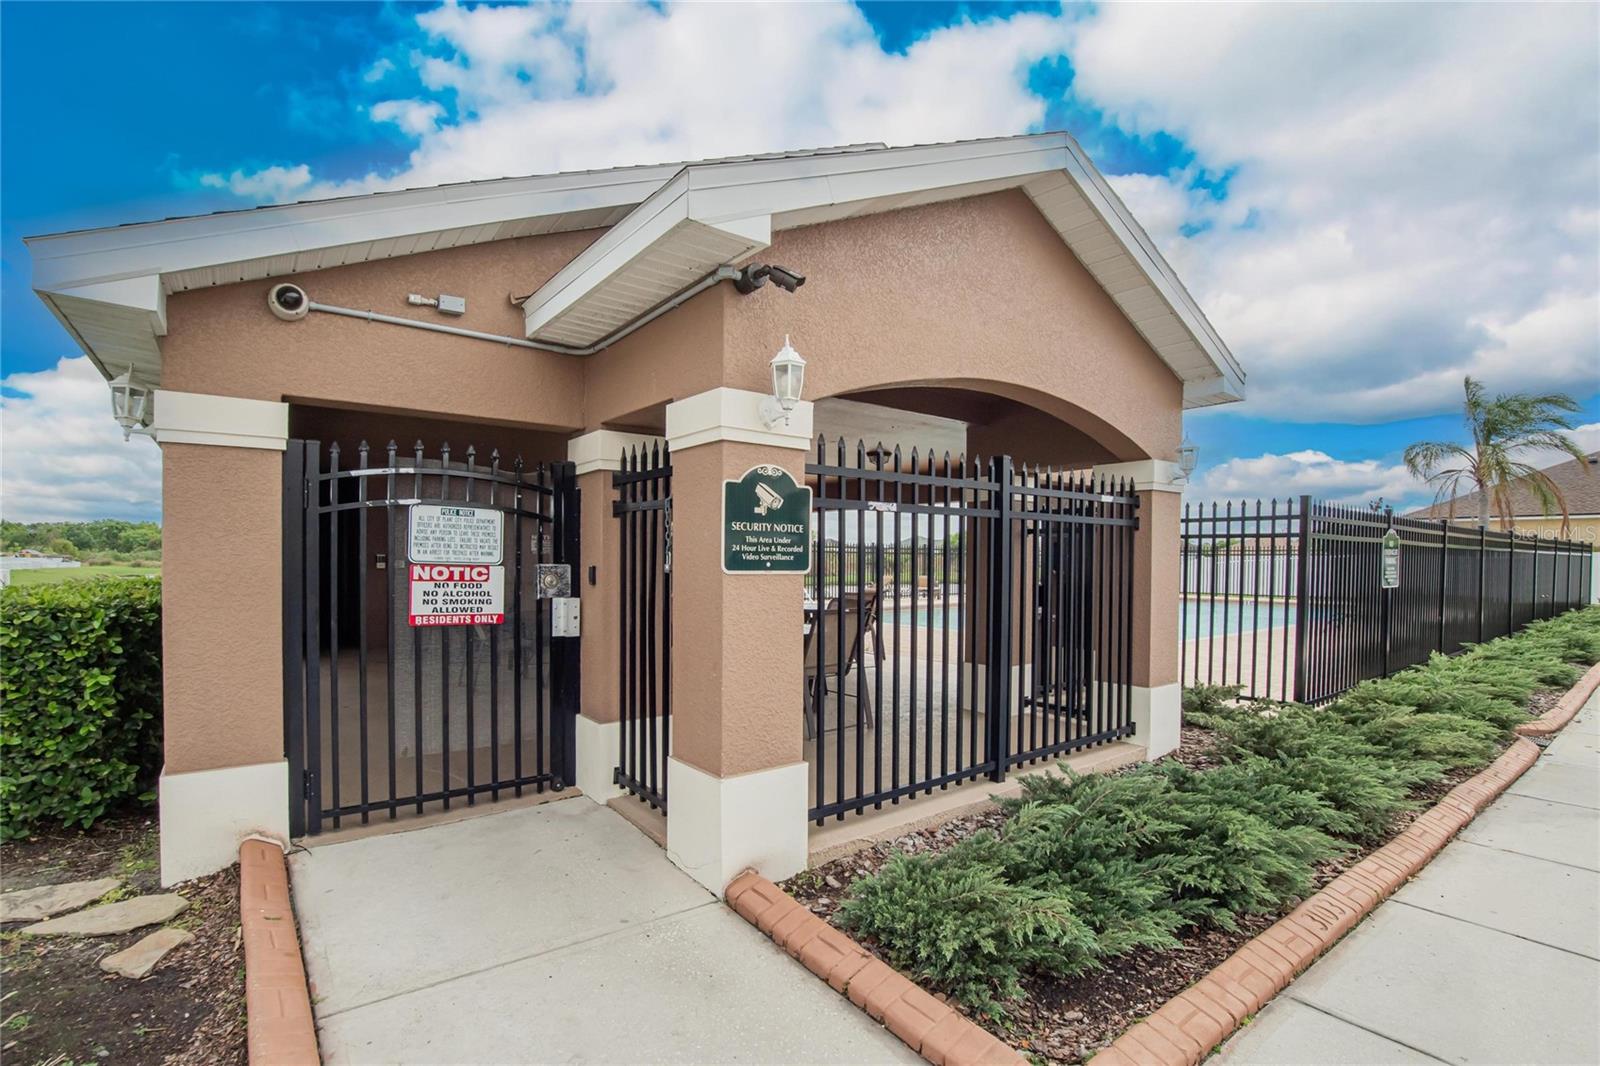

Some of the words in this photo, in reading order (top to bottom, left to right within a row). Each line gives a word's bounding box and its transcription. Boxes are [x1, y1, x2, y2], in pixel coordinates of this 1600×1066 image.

[732, 522, 771, 532] SECURITY
[774, 524, 803, 533] NOTICE
[416, 616, 471, 624] RESIDENTS
[475, 615, 498, 623] ONLY
